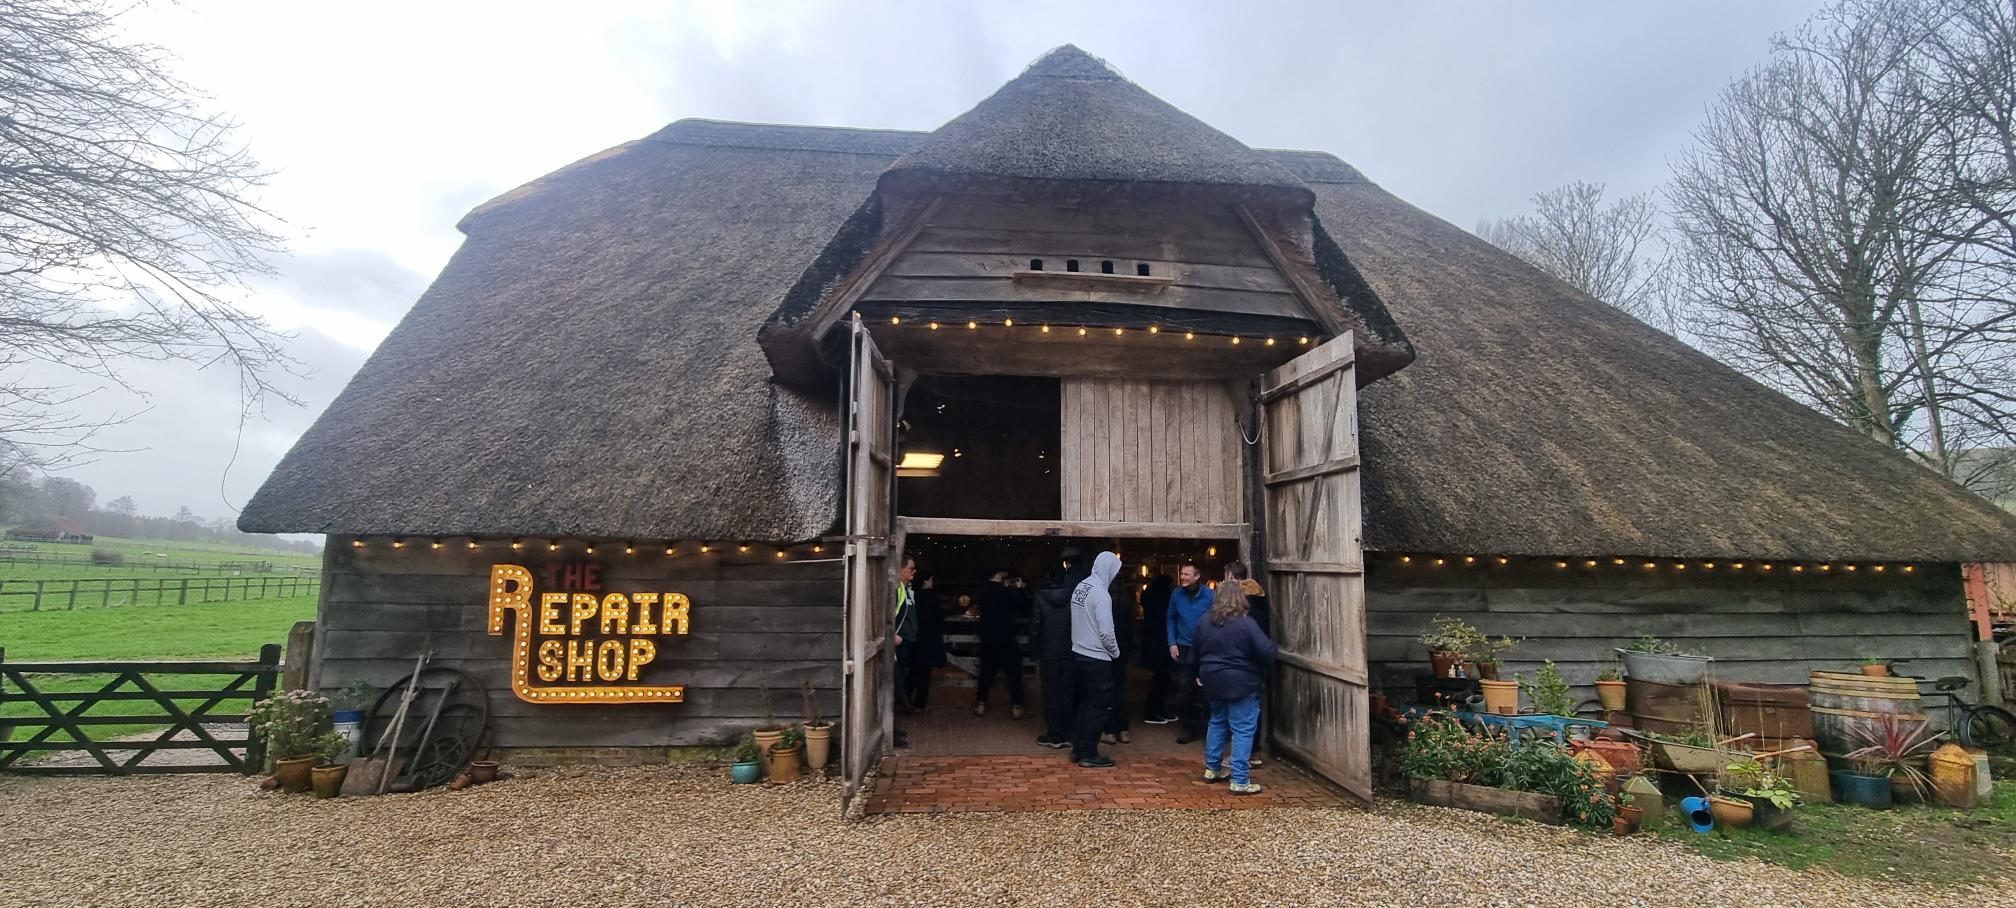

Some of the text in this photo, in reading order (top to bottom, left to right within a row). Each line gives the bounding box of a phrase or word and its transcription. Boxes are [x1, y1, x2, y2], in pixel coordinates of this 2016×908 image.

[545, 564, 606, 590] THE
[488, 564, 690, 703] REPAIR
[537, 638, 656, 682] SHOP
